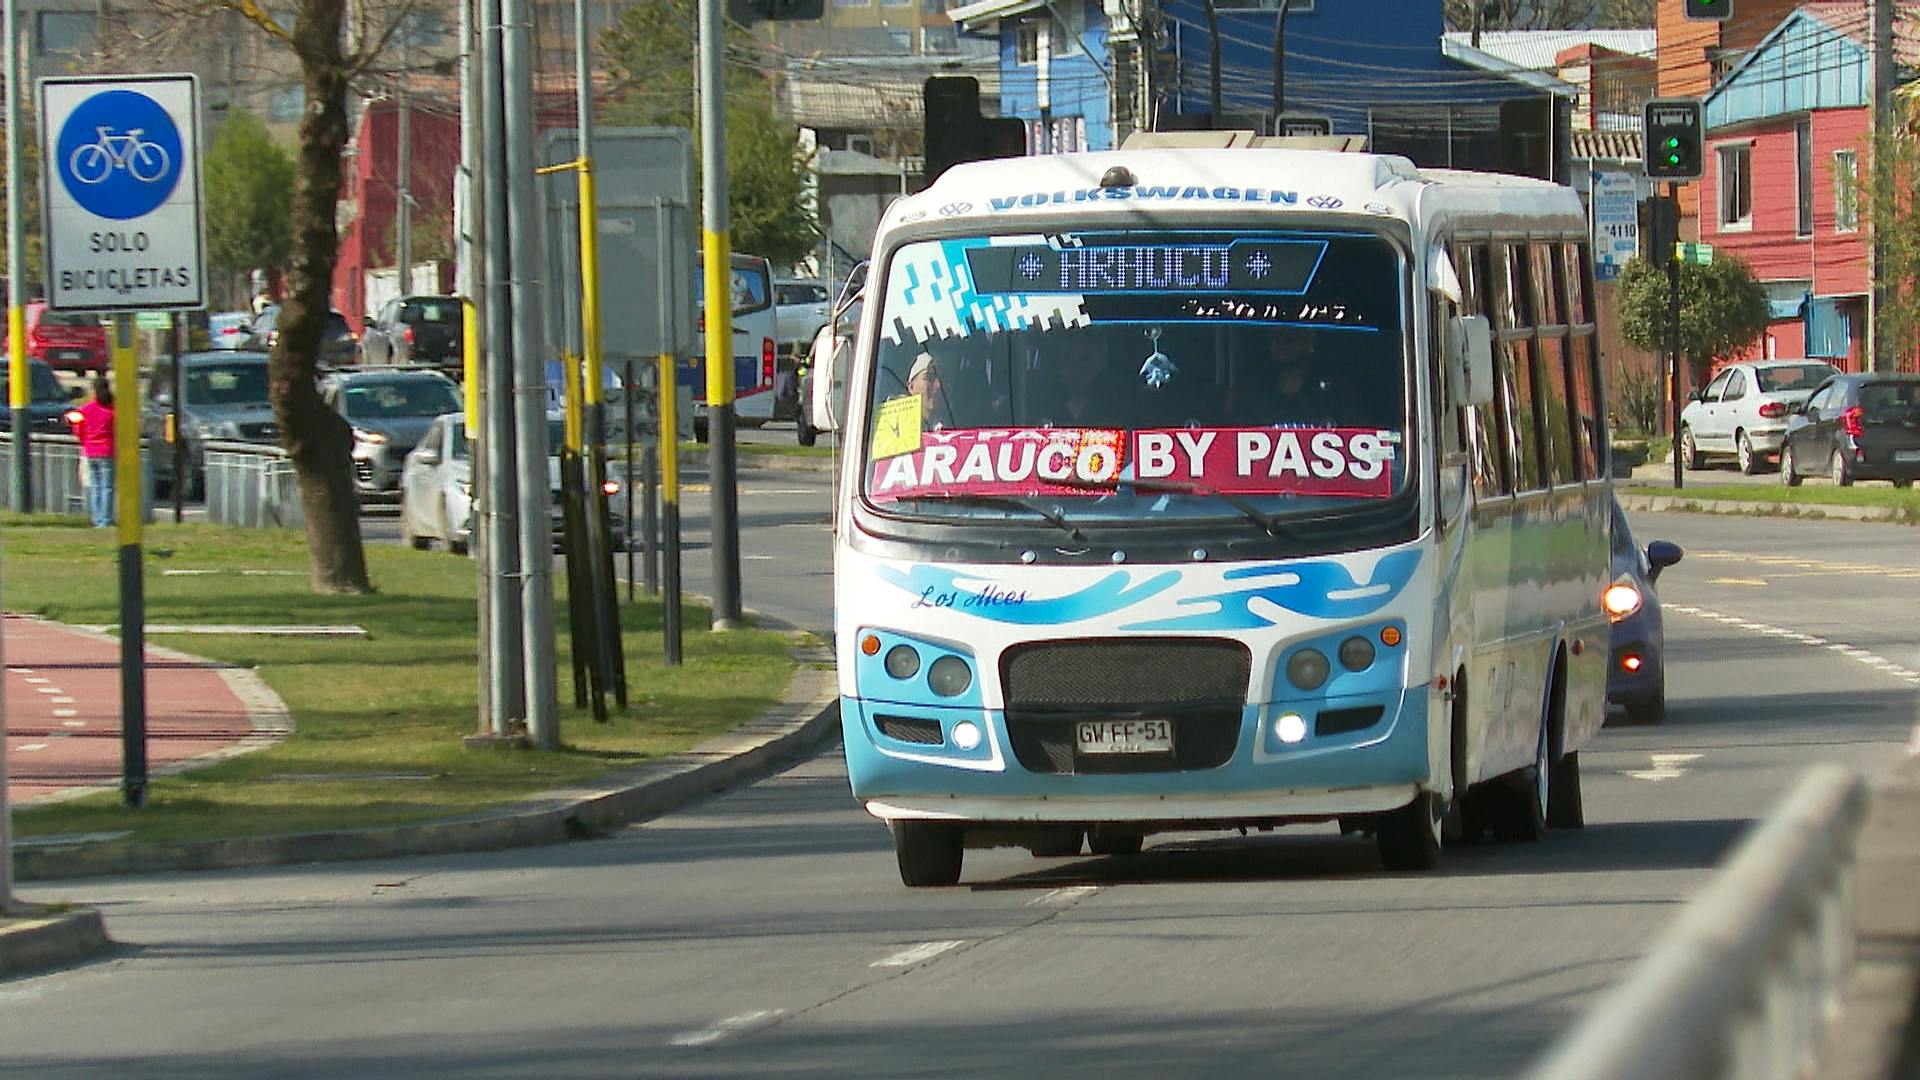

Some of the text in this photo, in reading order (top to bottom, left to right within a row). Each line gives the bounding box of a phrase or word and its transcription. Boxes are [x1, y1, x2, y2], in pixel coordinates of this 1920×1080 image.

[989, 186, 1298, 212] VOLKSWAGEN
[89, 231, 150, 253] SOLO
[60, 266, 191, 291] BICICLETAS
[1060, 247, 1229, 288] ARAUCO
[879, 432, 1384, 490] ARAUCO BY PASS
[911, 585, 957, 609] Los
